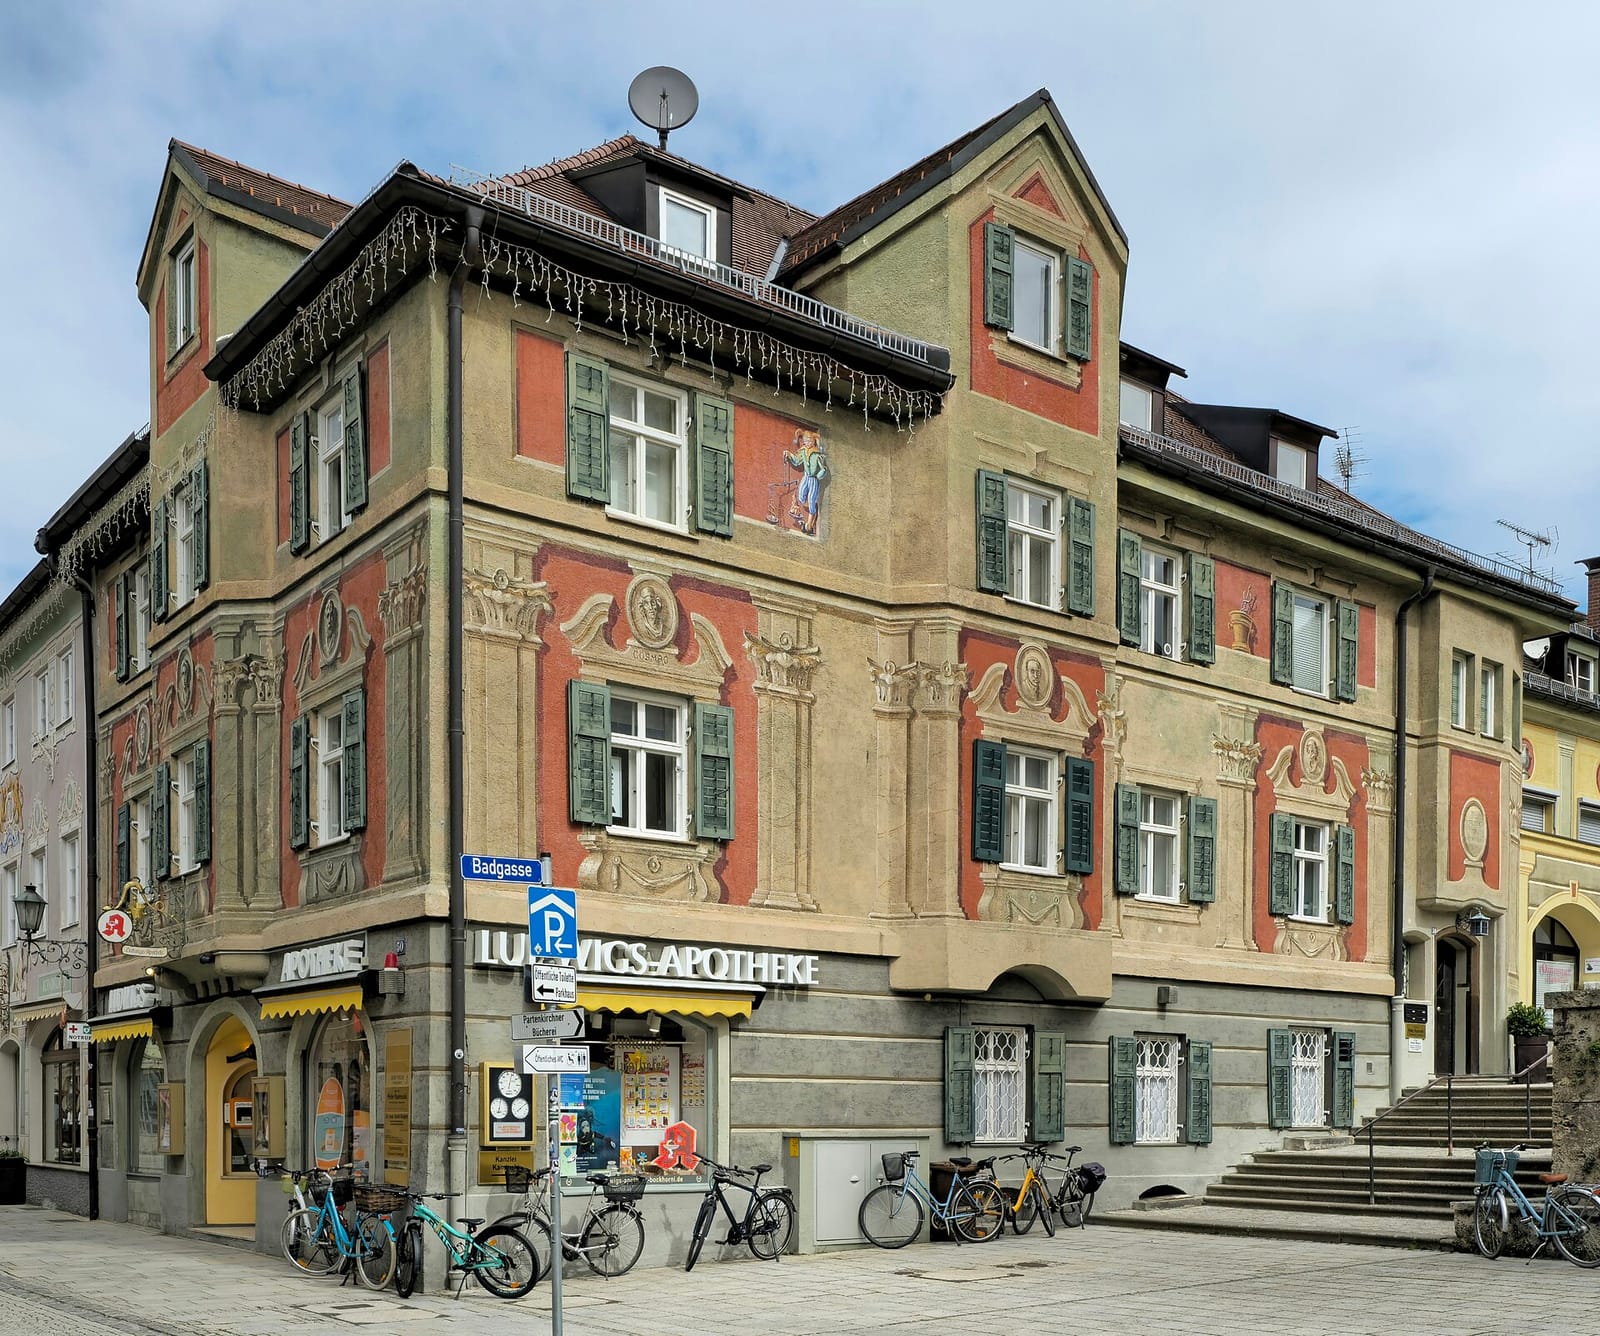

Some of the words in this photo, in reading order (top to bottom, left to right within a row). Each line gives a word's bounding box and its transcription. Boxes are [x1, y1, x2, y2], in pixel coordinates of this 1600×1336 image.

[472, 857, 533, 879] Badgasse
[543, 910, 565, 953] P
[280, 939, 364, 982] APOTHEKE
[535, 968, 559, 981] Öffentliche
[559, 971, 574, 983] Toilette
[555, 987, 574, 999] Parkhaus
[523, 1013, 565, 1024] Partenkirchner
[532, 1026, 557, 1037] Bücherei
